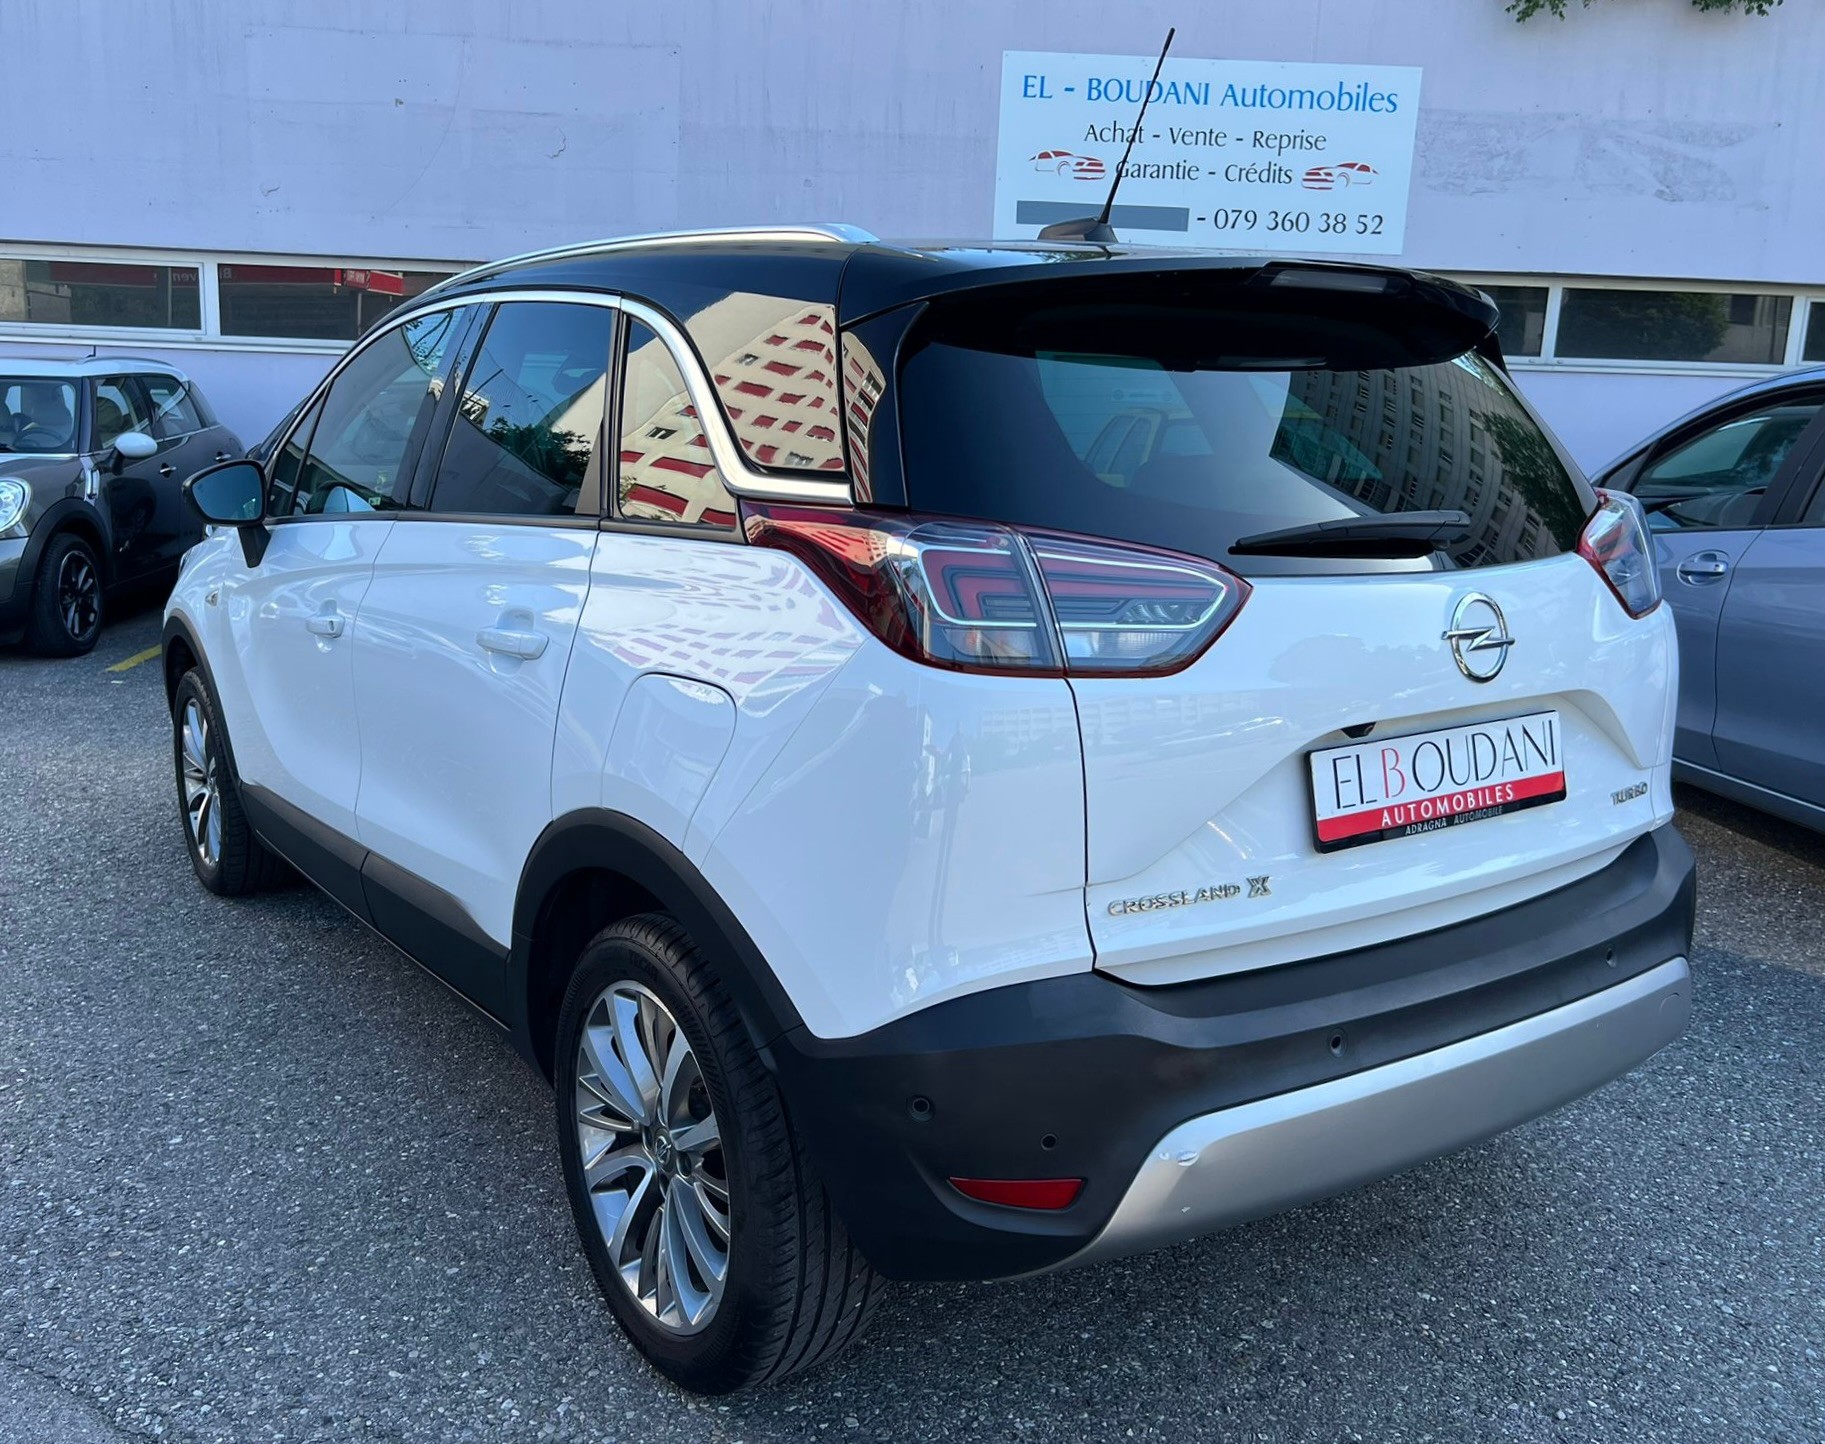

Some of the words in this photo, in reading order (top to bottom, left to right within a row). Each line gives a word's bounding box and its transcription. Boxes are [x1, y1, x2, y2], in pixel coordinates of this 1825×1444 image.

[1023, 75, 1053, 98] EL
[1086, 78, 1210, 105] BOUDANI
[1220, 81, 1399, 113] Automobiles
[1084, 120, 1144, 144] Achat
[1169, 127, 1228, 146] Vente
[1252, 129, 1327, 156] Reprise
[1115, 160, 1200, 180] Garantie
[1224, 160, 1293, 184] Crédits
[1213, 208, 1257, 230] 079
[1266, 210, 1310, 232] 360
[1318, 212, 1347, 234] 38
[1355, 214, 1383, 235] 52
[1381, 784, 1514, 827] AUTOMOBILES
[1610, 781, 1648, 806] TURBO
[1405, 817, 1447, 835] ADRAGNA
[1107, 883, 1241, 917] CROSSLAND
[1246, 875, 1273, 899] X
